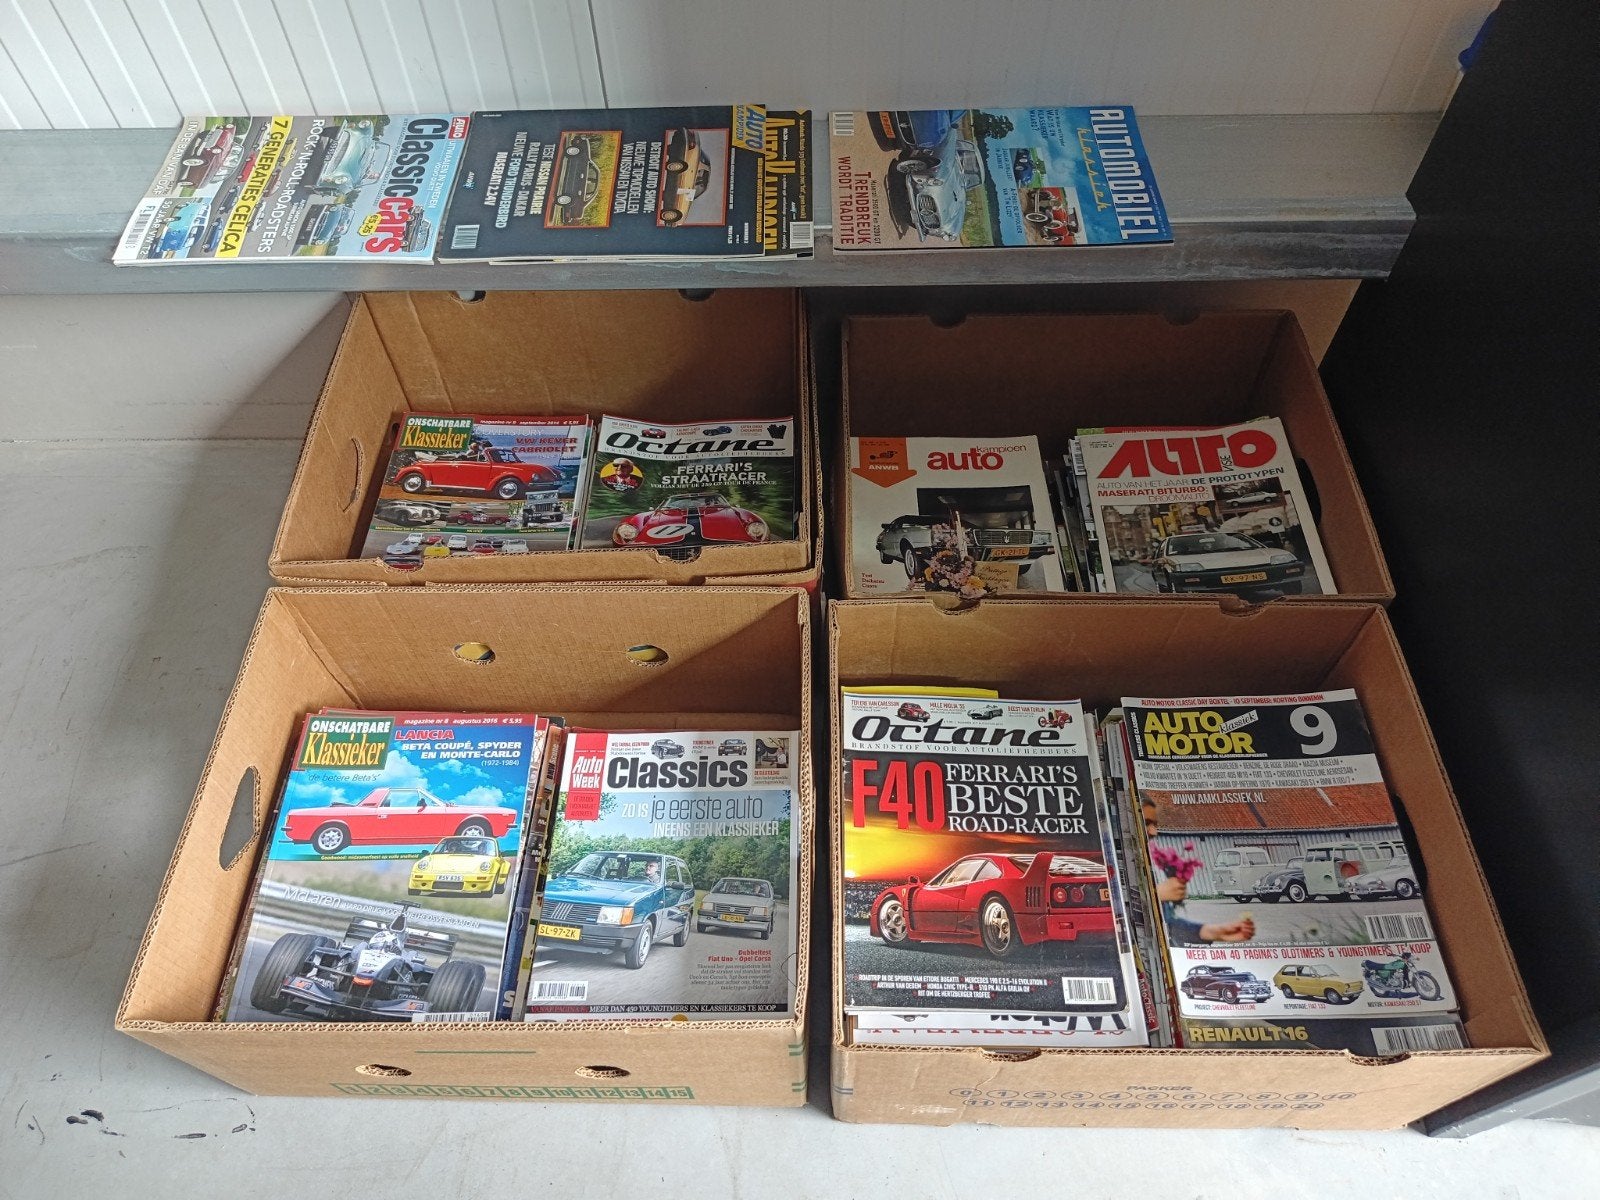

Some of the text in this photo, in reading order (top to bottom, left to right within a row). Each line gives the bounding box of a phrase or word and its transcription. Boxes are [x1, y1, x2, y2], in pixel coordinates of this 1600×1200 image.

[188, 121, 198, 130] IN
[745, 107, 766, 150] AUTO
[183, 132, 194, 142] DE
[172, 143, 187, 161] BAN
[443, 141, 457, 171] UITWAAIEN
[526, 142, 541, 163] RALLY
[162, 161, 178, 179] VAN
[488, 152, 508, 185] MASERATI
[495, 131, 528, 228] NIEUWE FORD THUNDERBIRD
[535, 161, 552, 186] NISSAN
[613, 143, 634, 213] VAN NISSAN EN TOYOTA
[627, 141, 647, 214] NIEUWE TOPMODELLEN
[643, 141, 662, 213] DETROIT AUTO SHOW:
[1076, 127, 1111, 212] klassiek
[1090, 109, 1159, 239] AUTOMOBIEL
[153, 180, 167, 195] DAF
[220, 120, 288, 252] 7 GENERATIES CELICA
[428, 182, 444, 208] ZWEDEN
[163, 200, 173, 209] 50
[513, 191, 529, 217] DAKAR
[530, 186, 548, 215] PRAIRIE
[838, 156, 854, 245] WORDT TRADITIE
[854, 171, 872, 245] TRENDBREUK
[408, 418, 472, 428] ONSCHATBARE
[401, 425, 467, 449] Klassieker
[605, 432, 786, 454] Octane
[927, 448, 1004, 470] auto
[976, 444, 1027, 453] kampioen
[1097, 429, 1277, 479] AUTO
[661, 472, 767, 485] STRAATRACER
[677, 462, 753, 475] FERRARI'S
[1097, 481, 1121, 489] AUTO
[1164, 479, 1190, 487] JAAR
[1191, 477, 1206, 485] DE
[1208, 467, 1285, 484] PROTOTYPEN
[1097, 486, 1209, 497] MASERATI BITURBO:
[654, 525, 687, 535] 17
[1223, 573, 1264, 583] KK-97-NS
[311, 721, 391, 733] ONSCHATBARE
[852, 715, 1077, 747] Octane
[1130, 712, 1139, 734] CLASSICS
[1144, 710, 1223, 733] AUTO
[1220, 711, 1257, 733] klassiek
[1290, 705, 1338, 755] 9
[395, 729, 455, 741] LANCIA
[402, 740, 522, 752] BETA COUPÉ, SPYDER
[1144, 732, 1256, 755] MOTOR
[302, 733, 385, 766] Klassieker
[420, 750, 521, 759] EN MONTE-CARLO
[852, 742, 919, 751] BRANDSTOF
[964, 746, 1077, 754] AUTOLIEFHEBBERS
[481, 759, 520, 767] (1972-1984)
[572, 756, 604, 773] Auto
[607, 756, 748, 788] Classics
[945, 763, 1077, 784] FERRARI'S
[322, 773, 350, 781] betere
[572, 773, 600, 788] Week
[852, 759, 945, 832] F40
[947, 784, 1084, 816] BESTE
[1171, 791, 1266, 805] WWW.AMKLASSIEK.NL
[621, 803, 636, 818] ZO
[638, 803, 648, 817] IS
[650, 795, 666, 823] je
[669, 796, 722, 819] eerste
[726, 795, 763, 819] auto
[654, 820, 779, 837] INEENS EEN KLASSIEKER
[948, 816, 1089, 834] ROAD-RACER
[282, 885, 342, 907] McLaren
[1186, 942, 1432, 960] MEER DAN 40 PAGINA'S OLDTIMERS & YOUNGTIMERS TE KOOP
[590, 1005, 610, 1013] MEER
[1188, 1026, 1308, 1042] RENAULT 16
